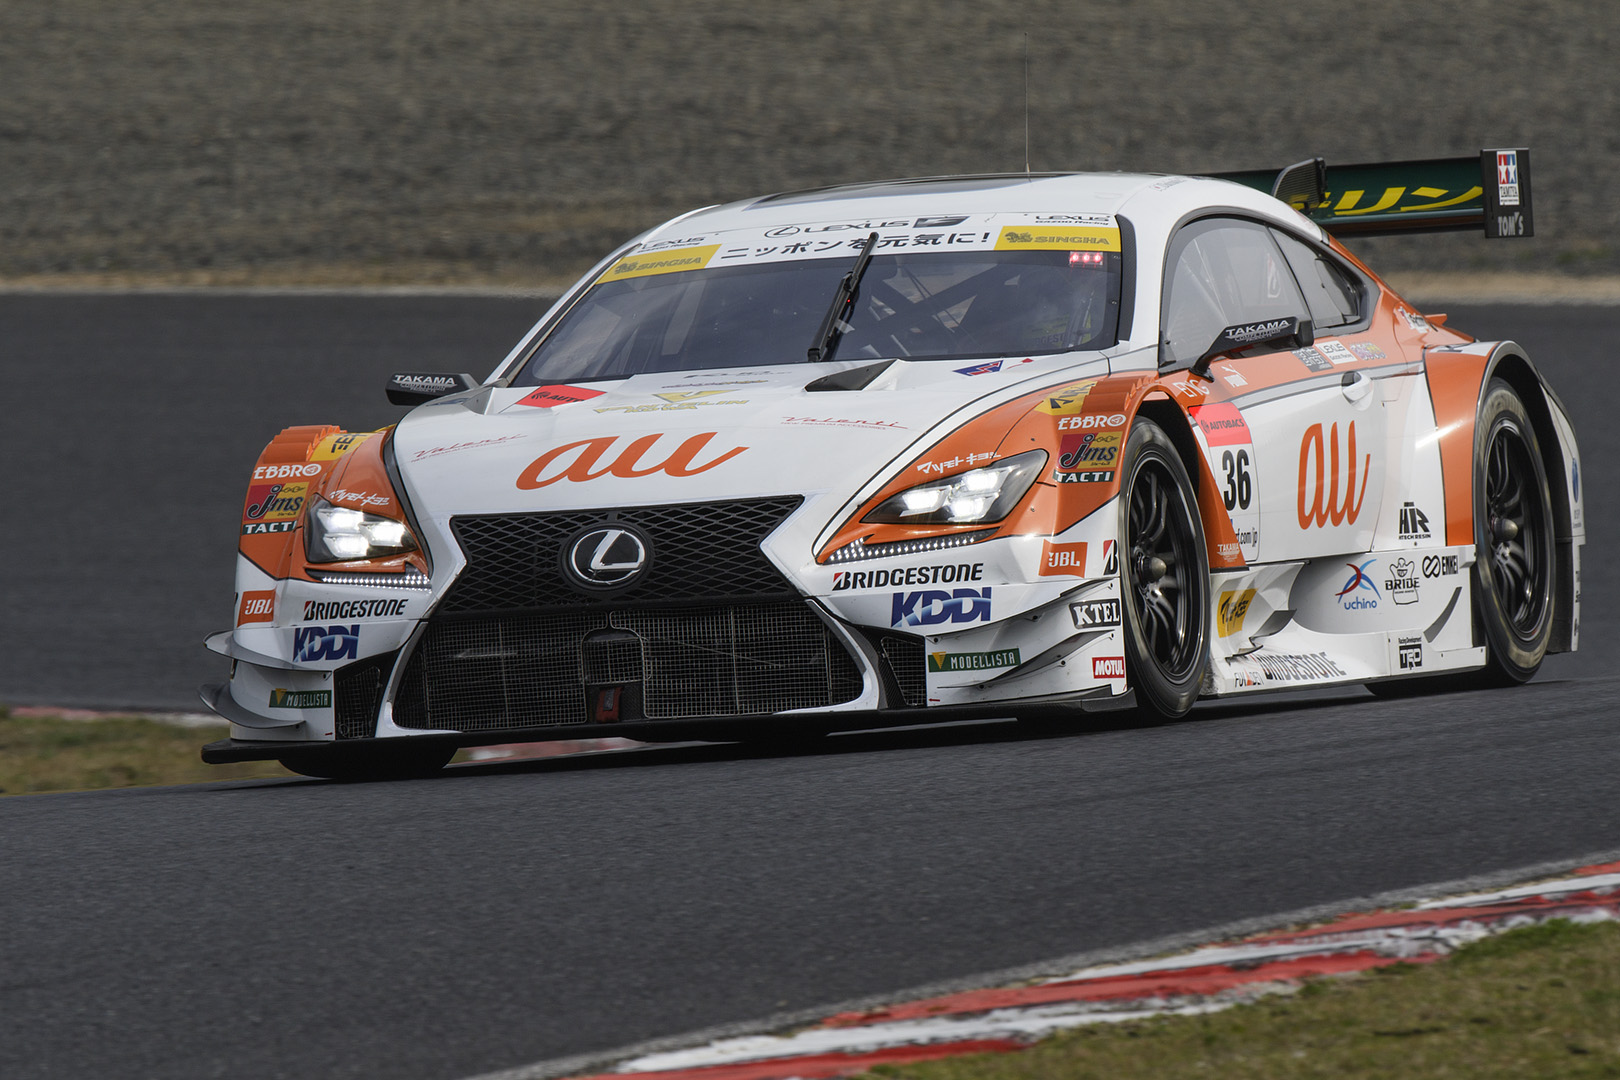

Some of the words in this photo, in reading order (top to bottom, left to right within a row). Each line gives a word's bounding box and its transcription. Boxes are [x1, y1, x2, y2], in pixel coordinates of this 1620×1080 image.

[804, 220, 910, 233] LEXUS
[1034, 235, 1110, 245] SINGHA
[635, 256, 702, 271] SINGHA
[1225, 320, 1290, 336] TAKAMA
[394, 374, 456, 385] TAKAMA
[1058, 414, 1127, 430] EBBRO
[1210, 418, 1245, 430] AUTOBACS
[516, 431, 749, 490] au
[253, 463, 322, 480] EBBRO
[1055, 471, 1111, 483] TACTI
[1298, 419, 1371, 530] au
[1222, 449, 1252, 511] 36
[1048, 551, 1080, 567] JBL
[832, 563, 984, 591] BRIDGESTONE
[1385, 577, 1420, 590] BRIDE
[245, 599, 273, 615] JBL
[304, 598, 409, 621] BRIDGESTONE
[891, 586, 992, 627] KDDI
[1344, 596, 1378, 610] uchino
[1073, 601, 1120, 626] KTEL
[293, 624, 360, 662] KDDI
[950, 652, 1016, 669] MODELLISTA
[1095, 660, 1125, 676] MOTUL
[286, 693, 329, 707] MODELLISTA
